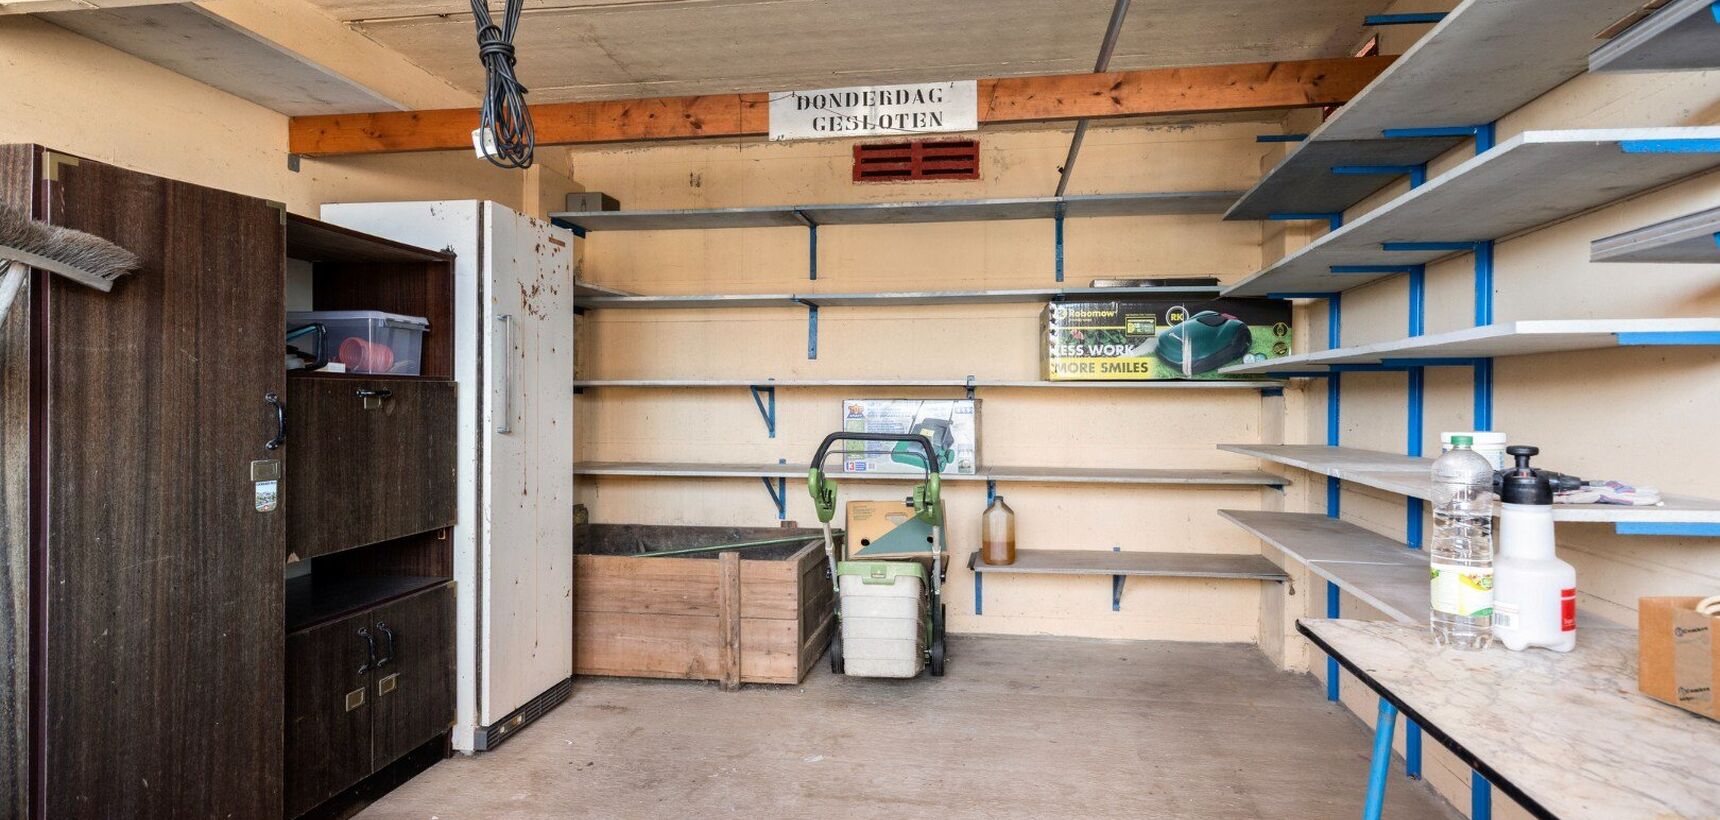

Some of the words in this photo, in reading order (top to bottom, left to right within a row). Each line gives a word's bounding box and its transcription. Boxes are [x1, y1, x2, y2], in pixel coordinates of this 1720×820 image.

[797, 88, 943, 110] DONDERDAG
[813, 111, 943, 132] GESLOTEN
[1069, 309, 1115, 318] Robomow
[1089, 344, 1135, 356] WORK
[1055, 362, 1095, 373] MORE
[1101, 362, 1148, 373] SMILES
